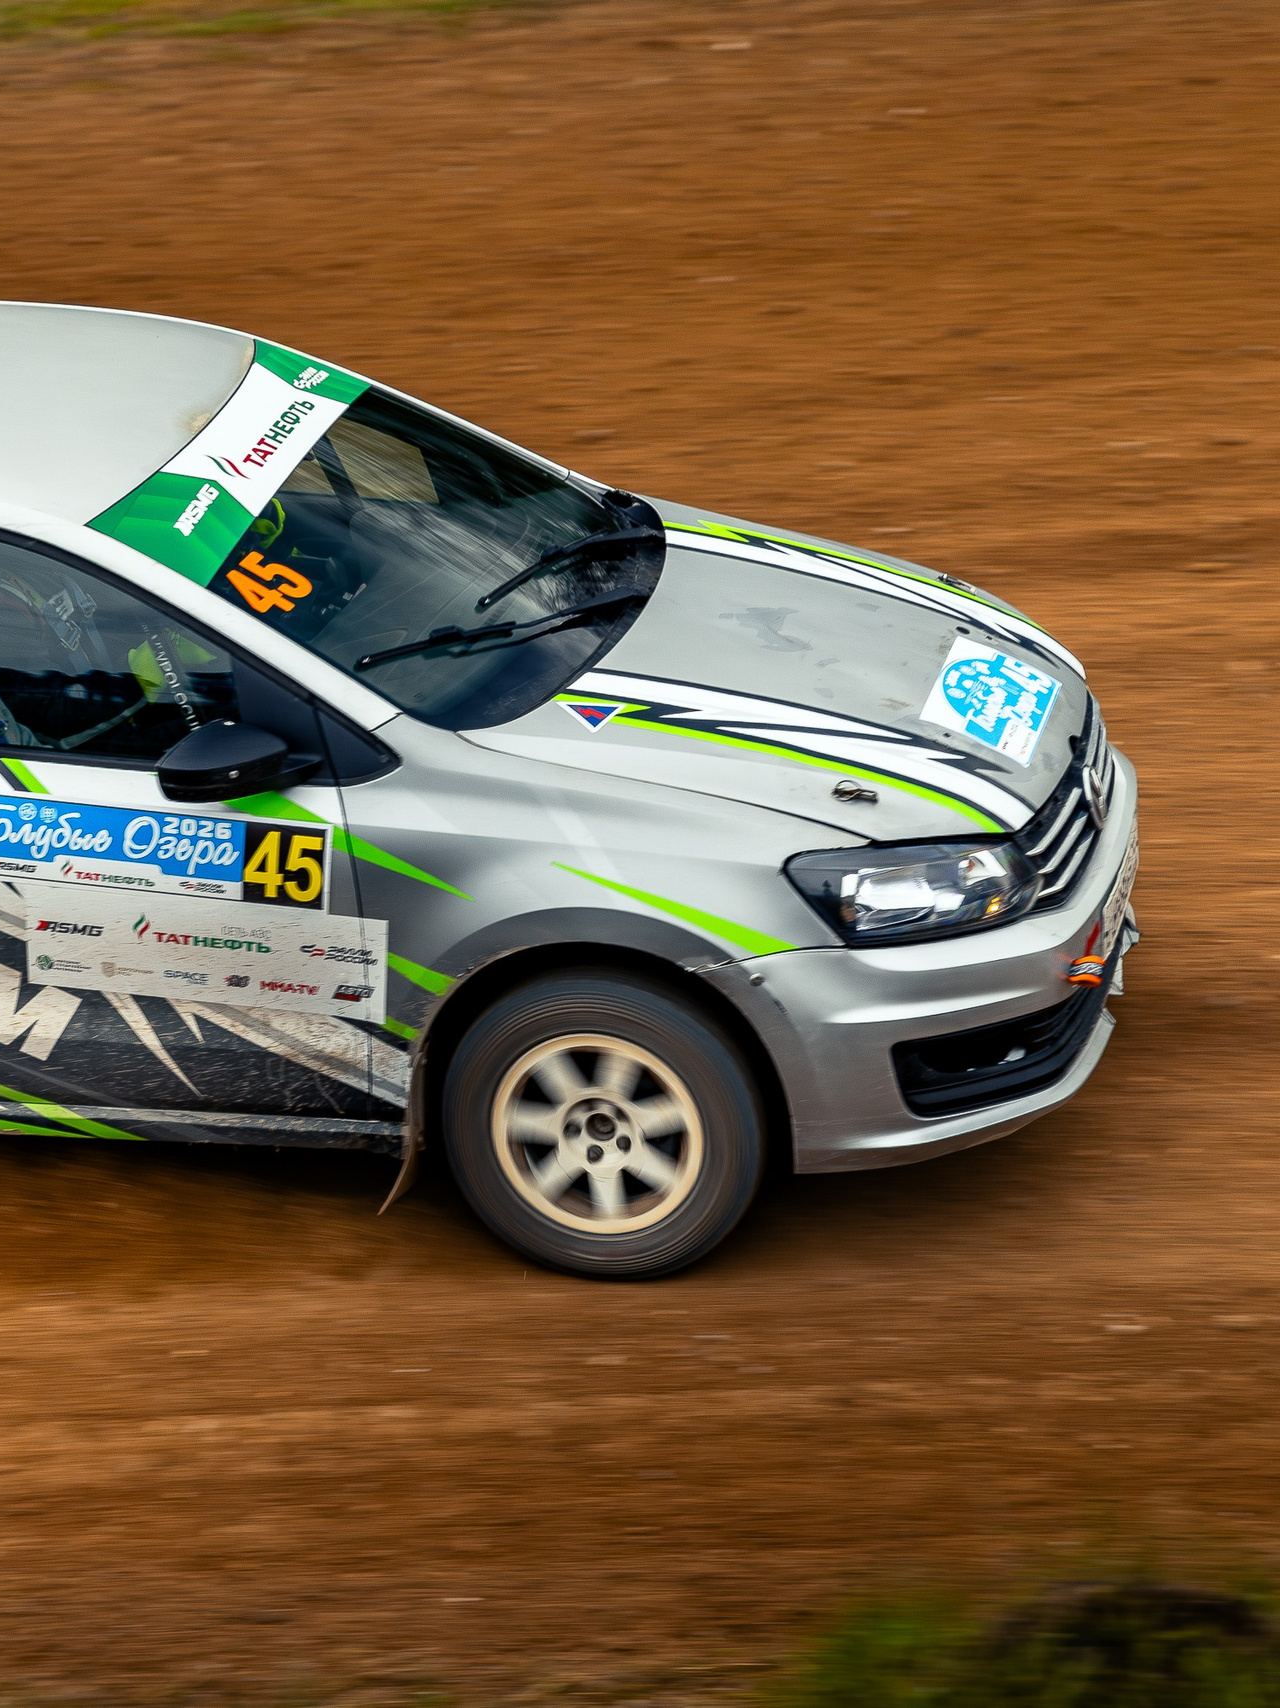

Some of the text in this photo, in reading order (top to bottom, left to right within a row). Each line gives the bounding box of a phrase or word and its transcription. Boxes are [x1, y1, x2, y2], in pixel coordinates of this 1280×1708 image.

[242, 399, 315, 468] ТАТНЕФТЬ
[226, 551, 313, 613] 45
[122, 815, 241, 876] Озера
[162, 816, 232, 840] 2026
[73, 870, 156, 887] ТАТНЕФТЬ
[243, 831, 324, 903] 45
[152, 931, 272, 954] ТАТНЕФТЬ
